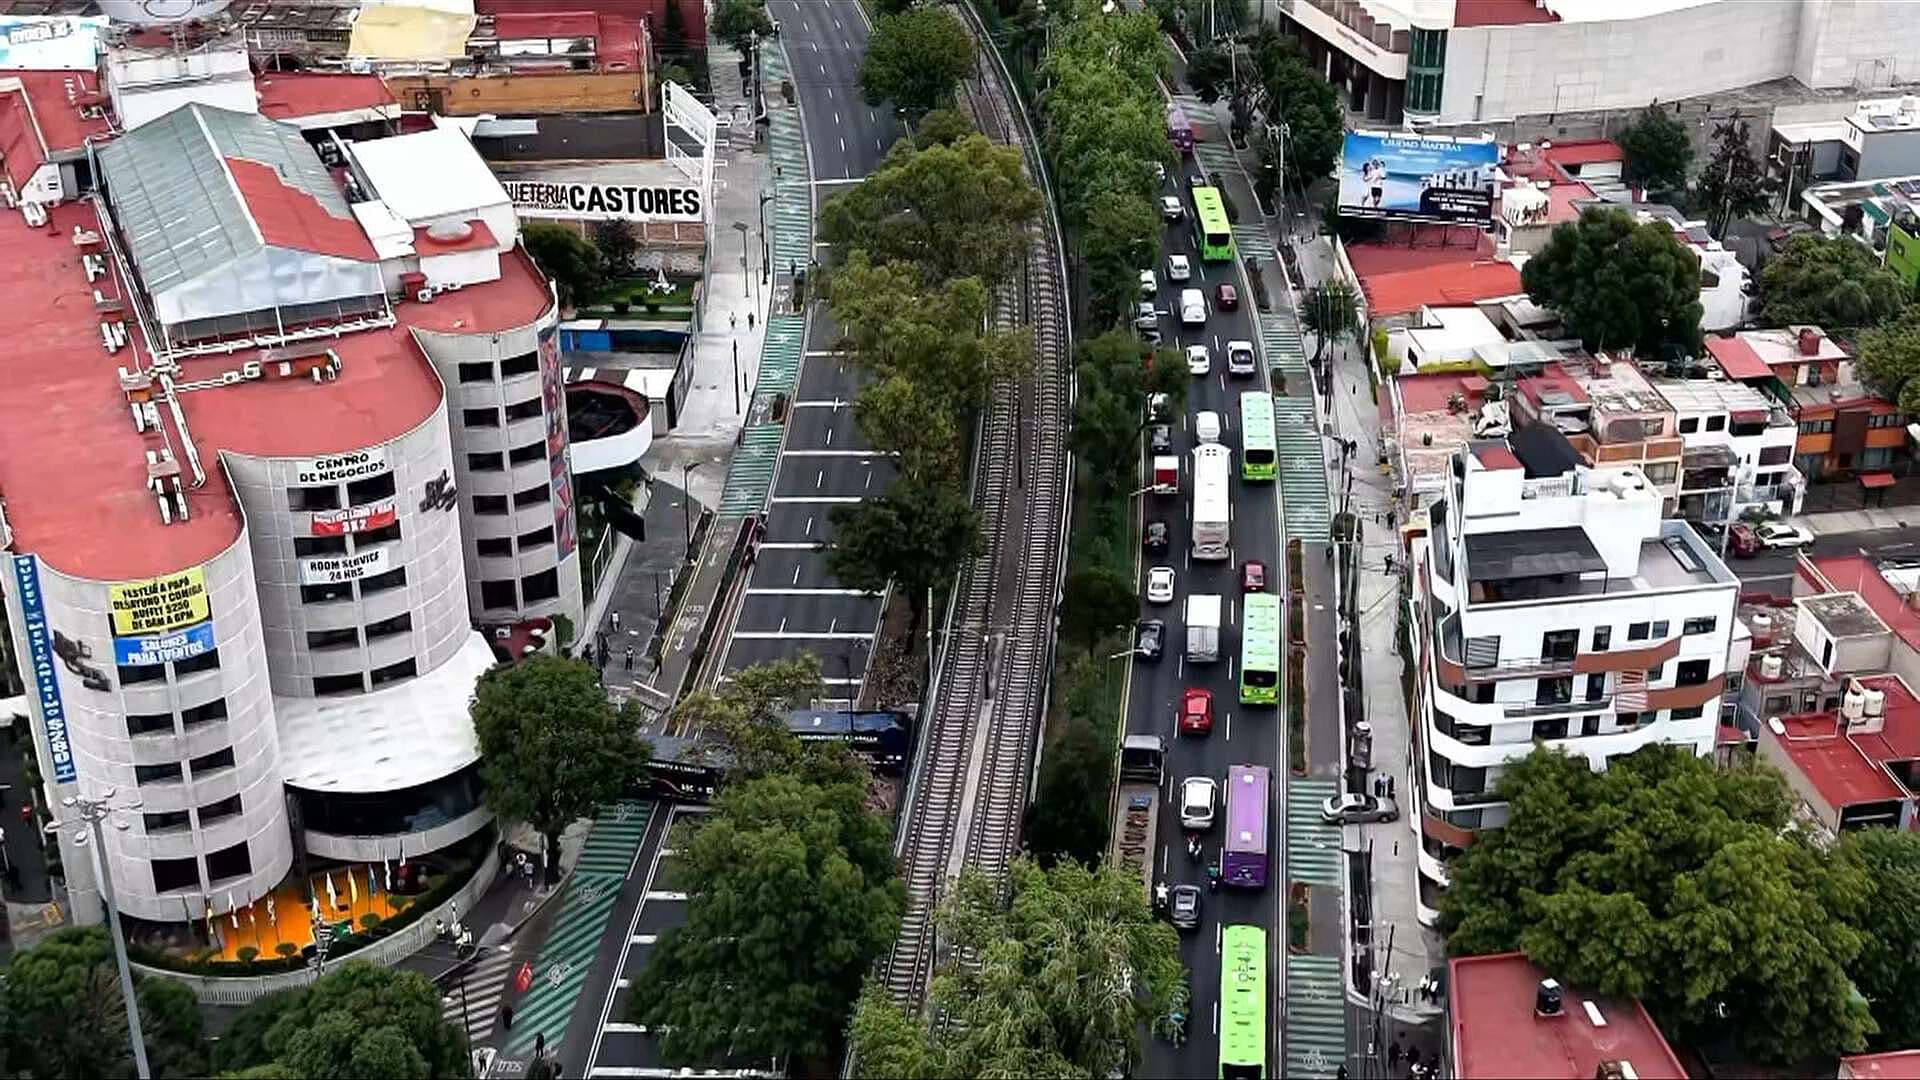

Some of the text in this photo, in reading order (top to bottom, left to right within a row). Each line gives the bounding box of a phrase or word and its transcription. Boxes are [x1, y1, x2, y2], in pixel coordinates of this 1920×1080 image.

[569, 184, 700, 215] CASTORES
[300, 460, 385, 482] DE NEGOCIOS
[315, 453, 369, 471] CENTRO
[310, 551, 379, 571] ROOM SERVICE
[329, 567, 364, 582] 24 HRS
[113, 584, 203, 610] DESAYUNO Y COMIDA
[160, 583, 166, 592] A
[132, 605, 163, 620] BUFFET
[131, 620, 144, 630] DE
[167, 615, 174, 625] A
[140, 633, 188, 652] SALONES
[128, 640, 204, 665] PARA EVENTOS
